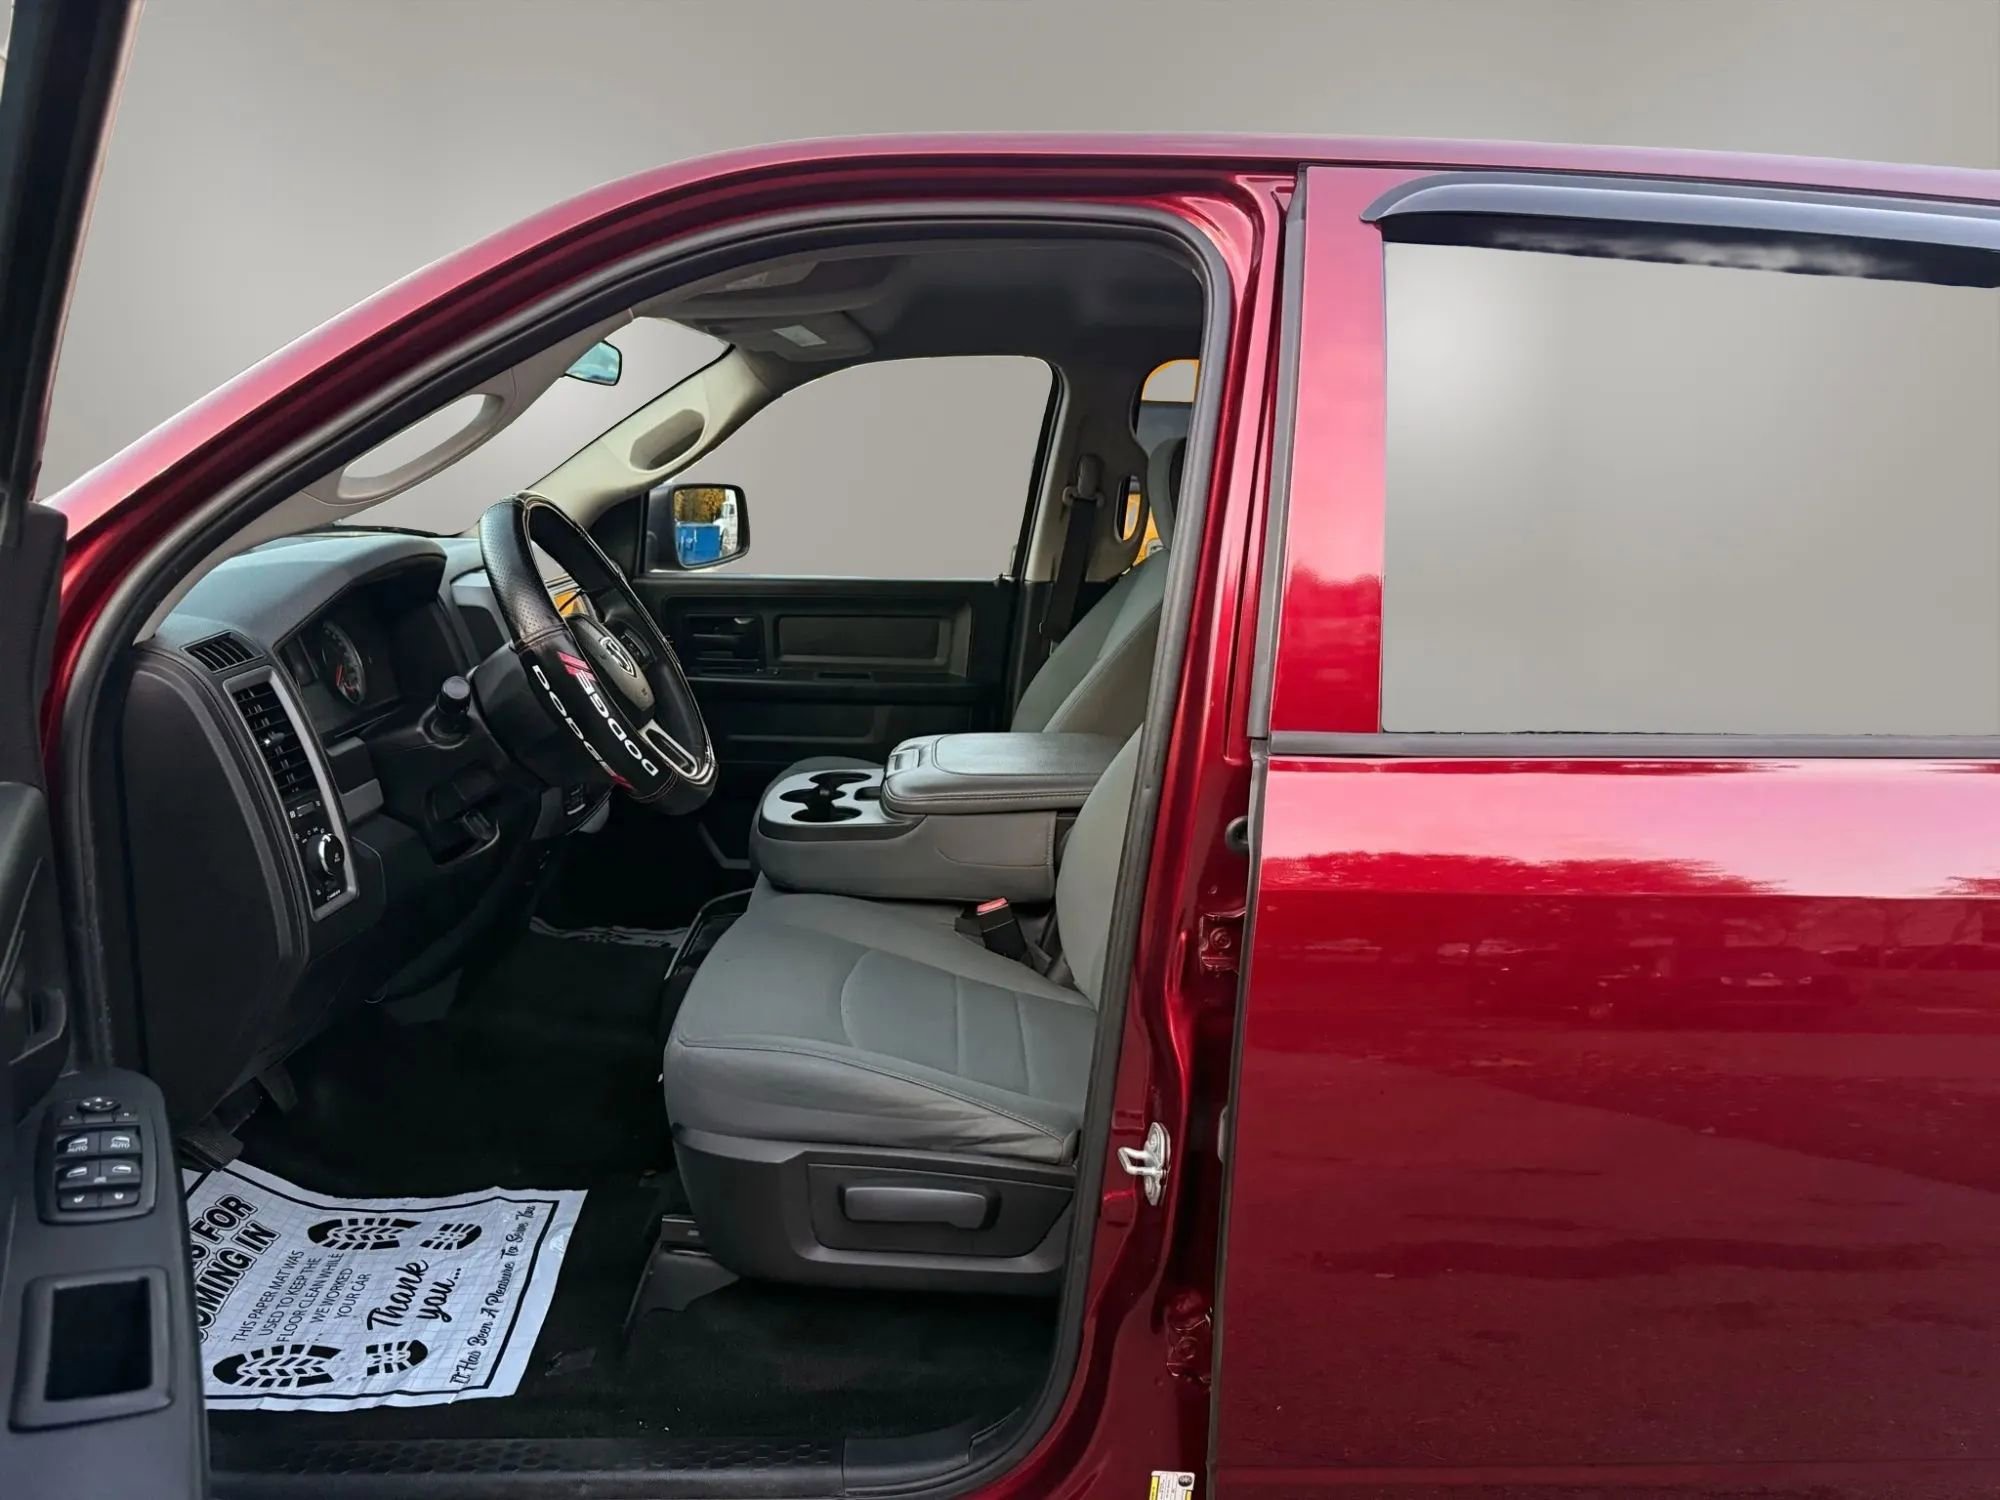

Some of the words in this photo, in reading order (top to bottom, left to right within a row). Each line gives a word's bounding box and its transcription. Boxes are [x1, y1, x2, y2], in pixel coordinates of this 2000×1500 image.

[532, 664, 617, 777] DODGE
[575, 671, 660, 777] DODGE
[190, 1194, 259, 1245] FOR
[505, 1222, 529, 1243] Serve
[515, 1205, 537, 1221] You
[500, 1245, 520, 1260] To
[194, 1247, 258, 1344] OMING
[230, 1219, 282, 1255] IN
[231, 1320, 258, 1343] THIS
[248, 1290, 277, 1321] PAPER
[268, 1268, 291, 1291] MAT
[282, 1249, 305, 1269] WAS
[258, 1310, 285, 1337] USED
[275, 1296, 295, 1312] TO
[285, 1274, 308, 1297] KEEP
[300, 1257, 322, 1275] THE
[276, 1309, 308, 1343] FLOOR
[298, 1280, 325, 1310] CLEAN
[317, 1252, 345, 1282] WHILE
[309, 1307, 331, 1324] WE
[322, 1267, 354, 1309] WORKED
[334, 1292, 362, 1320] YOUR
[351, 1272, 372, 1293] CAR
[366, 1259, 430, 1331] Thank
[484, 1261, 516, 1306] Pleasure
[467, 1321, 494, 1347] Been
[480, 1307, 500, 1319] A
[455, 1350, 482, 1373] Has
